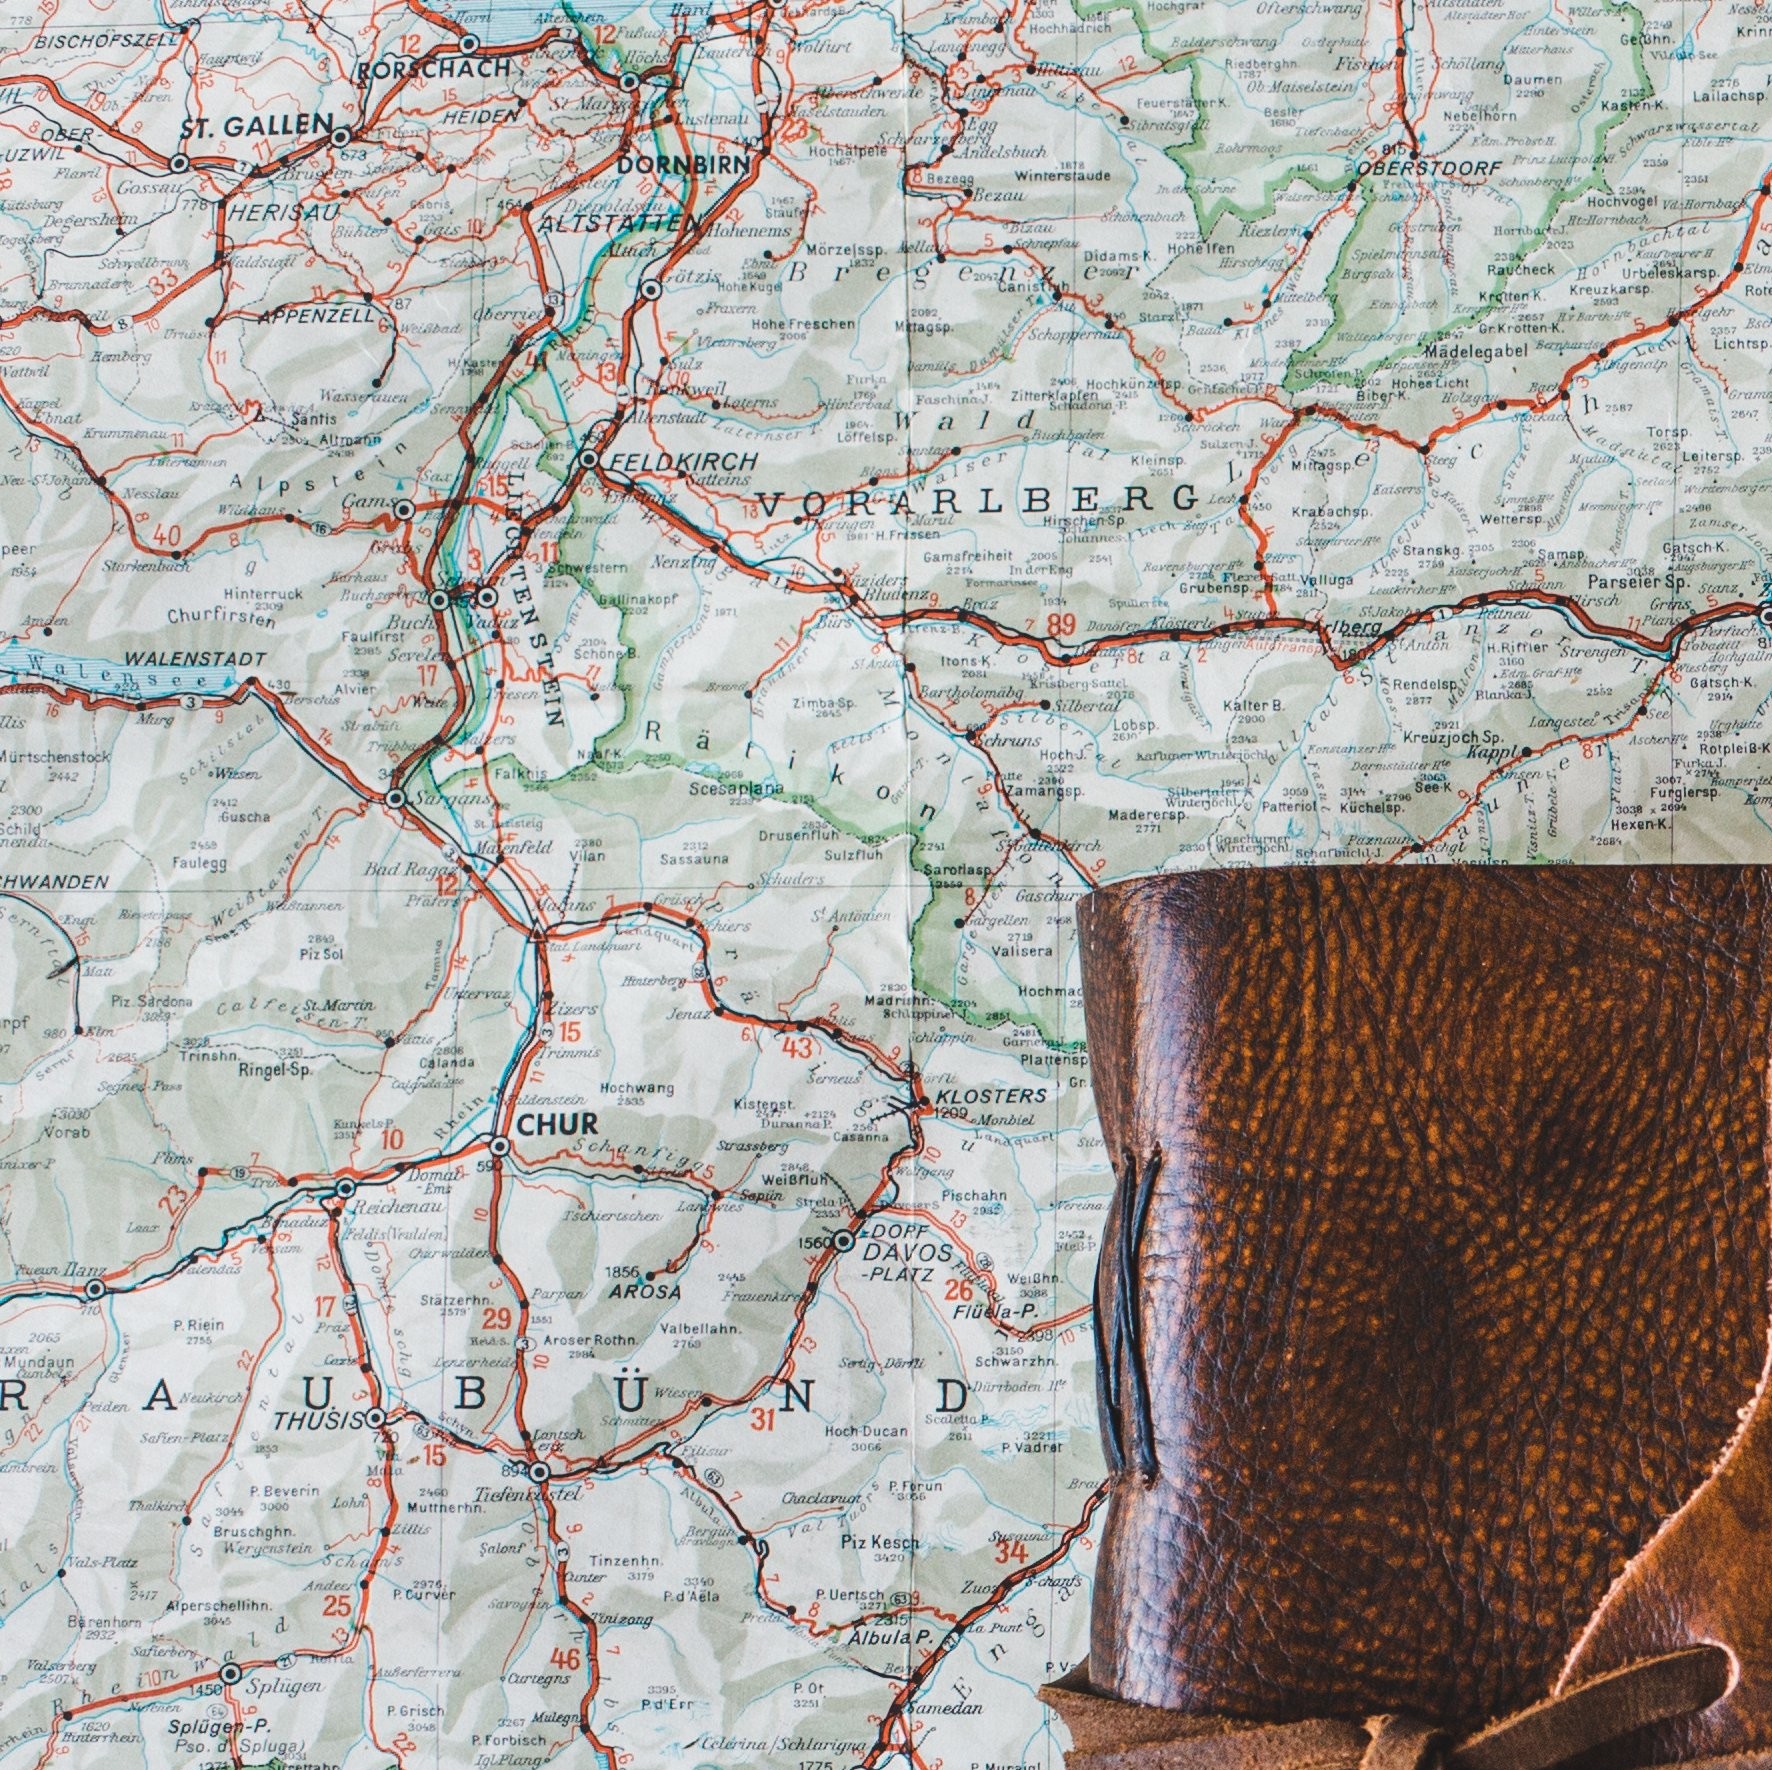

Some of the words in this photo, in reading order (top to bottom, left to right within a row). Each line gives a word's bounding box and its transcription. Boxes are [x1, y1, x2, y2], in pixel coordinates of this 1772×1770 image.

[34, 32, 179, 51] BISCHOFSZELL
[357, 58, 512, 80] RORSCHACH
[442, 106, 523, 125] HEIDEN
[1444, 109, 1516, 121] Nebelhorn
[180, 114, 213, 139] ST.
[224, 111, 335, 138] GALLEN
[615, 153, 751, 176] DORNBIRN
[1357, 159, 1502, 179] OBERSTDORF
[1015, 168, 1110, 181] Winterstaude
[1588, 194, 1657, 210] Hochvogel
[226, 202, 341, 224] HERISAU
[707, 221, 792, 237] Hohenems
[1488, 263, 1554, 277] Raucheck
[256, 305, 375, 325] APPENZELL
[1424, 341, 1527, 360] Mädelegabel
[608, 449, 758, 473] FELDKIRCH
[752, 480, 1204, 516] VORARLBERG
[1293, 503, 1370, 520] Krabachsp.
[168, 608, 276, 629] Churfirsten
[123, 652, 266, 668] WALENSTADT
[418, 664, 437, 686] 17
[690, 779, 784, 798] Scesaplana
[783, 1036, 813, 1058] 43
[239, 1061, 312, 1079] Ringel-Sp.
[601, 1083, 673, 1096] Hochwang
[517, 1113, 598, 1136] CHUR
[606, 1266, 641, 1279] 1856
[608, 1282, 680, 1300] AROSA
[483, 1308, 511, 1329] 29
[661, 1323, 742, 1334] Valbellahn.
[275, 1409, 365, 1430] THUSIS
[551, 1648, 580, 1670] 46
[244, 1676, 324, 1696] Splügen
